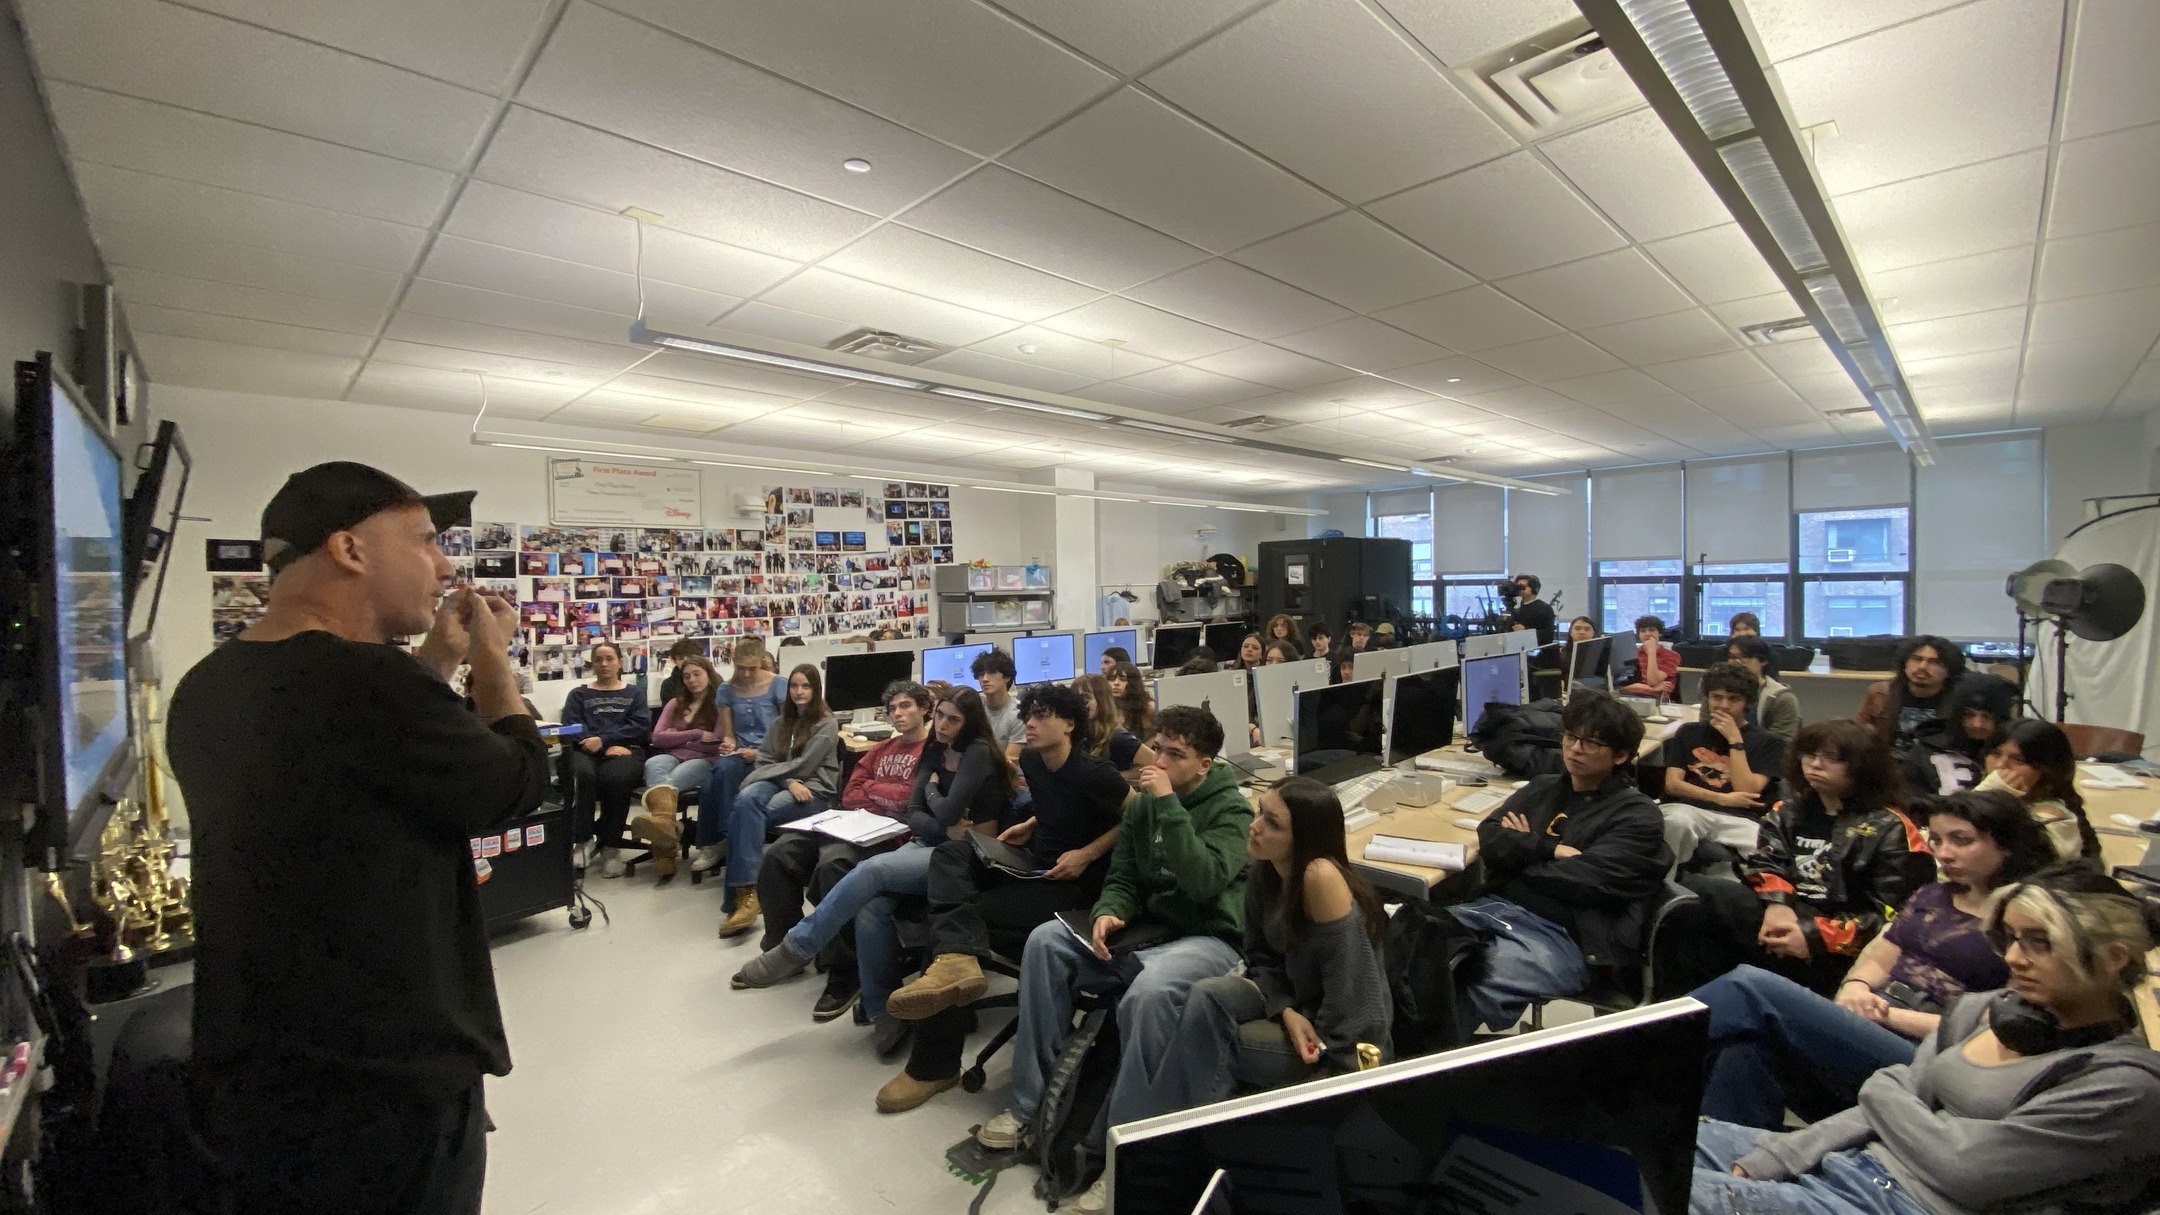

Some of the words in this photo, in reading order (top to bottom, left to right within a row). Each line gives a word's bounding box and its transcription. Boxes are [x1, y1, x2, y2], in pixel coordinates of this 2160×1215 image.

[593, 466, 610, 474] First
[612, 467, 631, 475] Place
[633, 469, 657, 477] Award
[663, 506, 692, 520] Disney
[876, 764, 912, 780] AVIDSO
